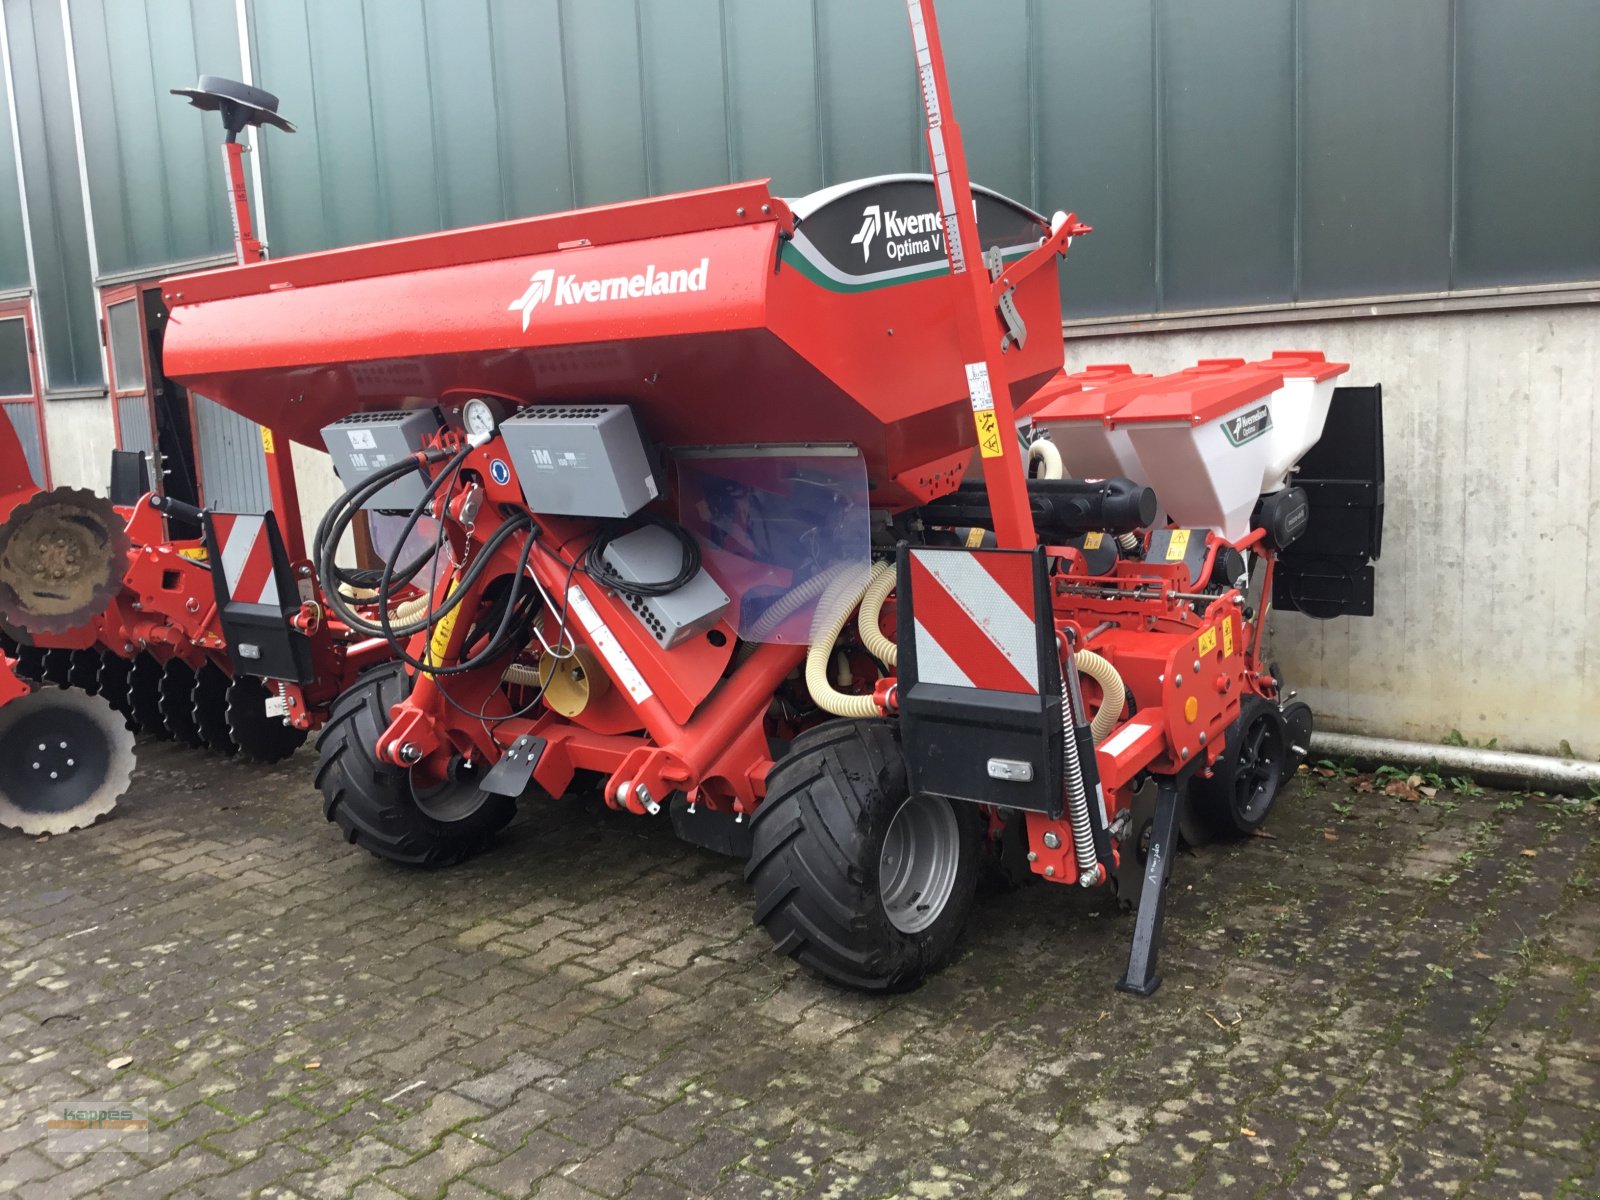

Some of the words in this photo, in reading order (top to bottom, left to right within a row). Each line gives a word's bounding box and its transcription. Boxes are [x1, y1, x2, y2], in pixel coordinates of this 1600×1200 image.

[886, 238, 930, 261] Optima
[931, 233, 940, 251] V
[554, 257, 709, 306] Kverneland
